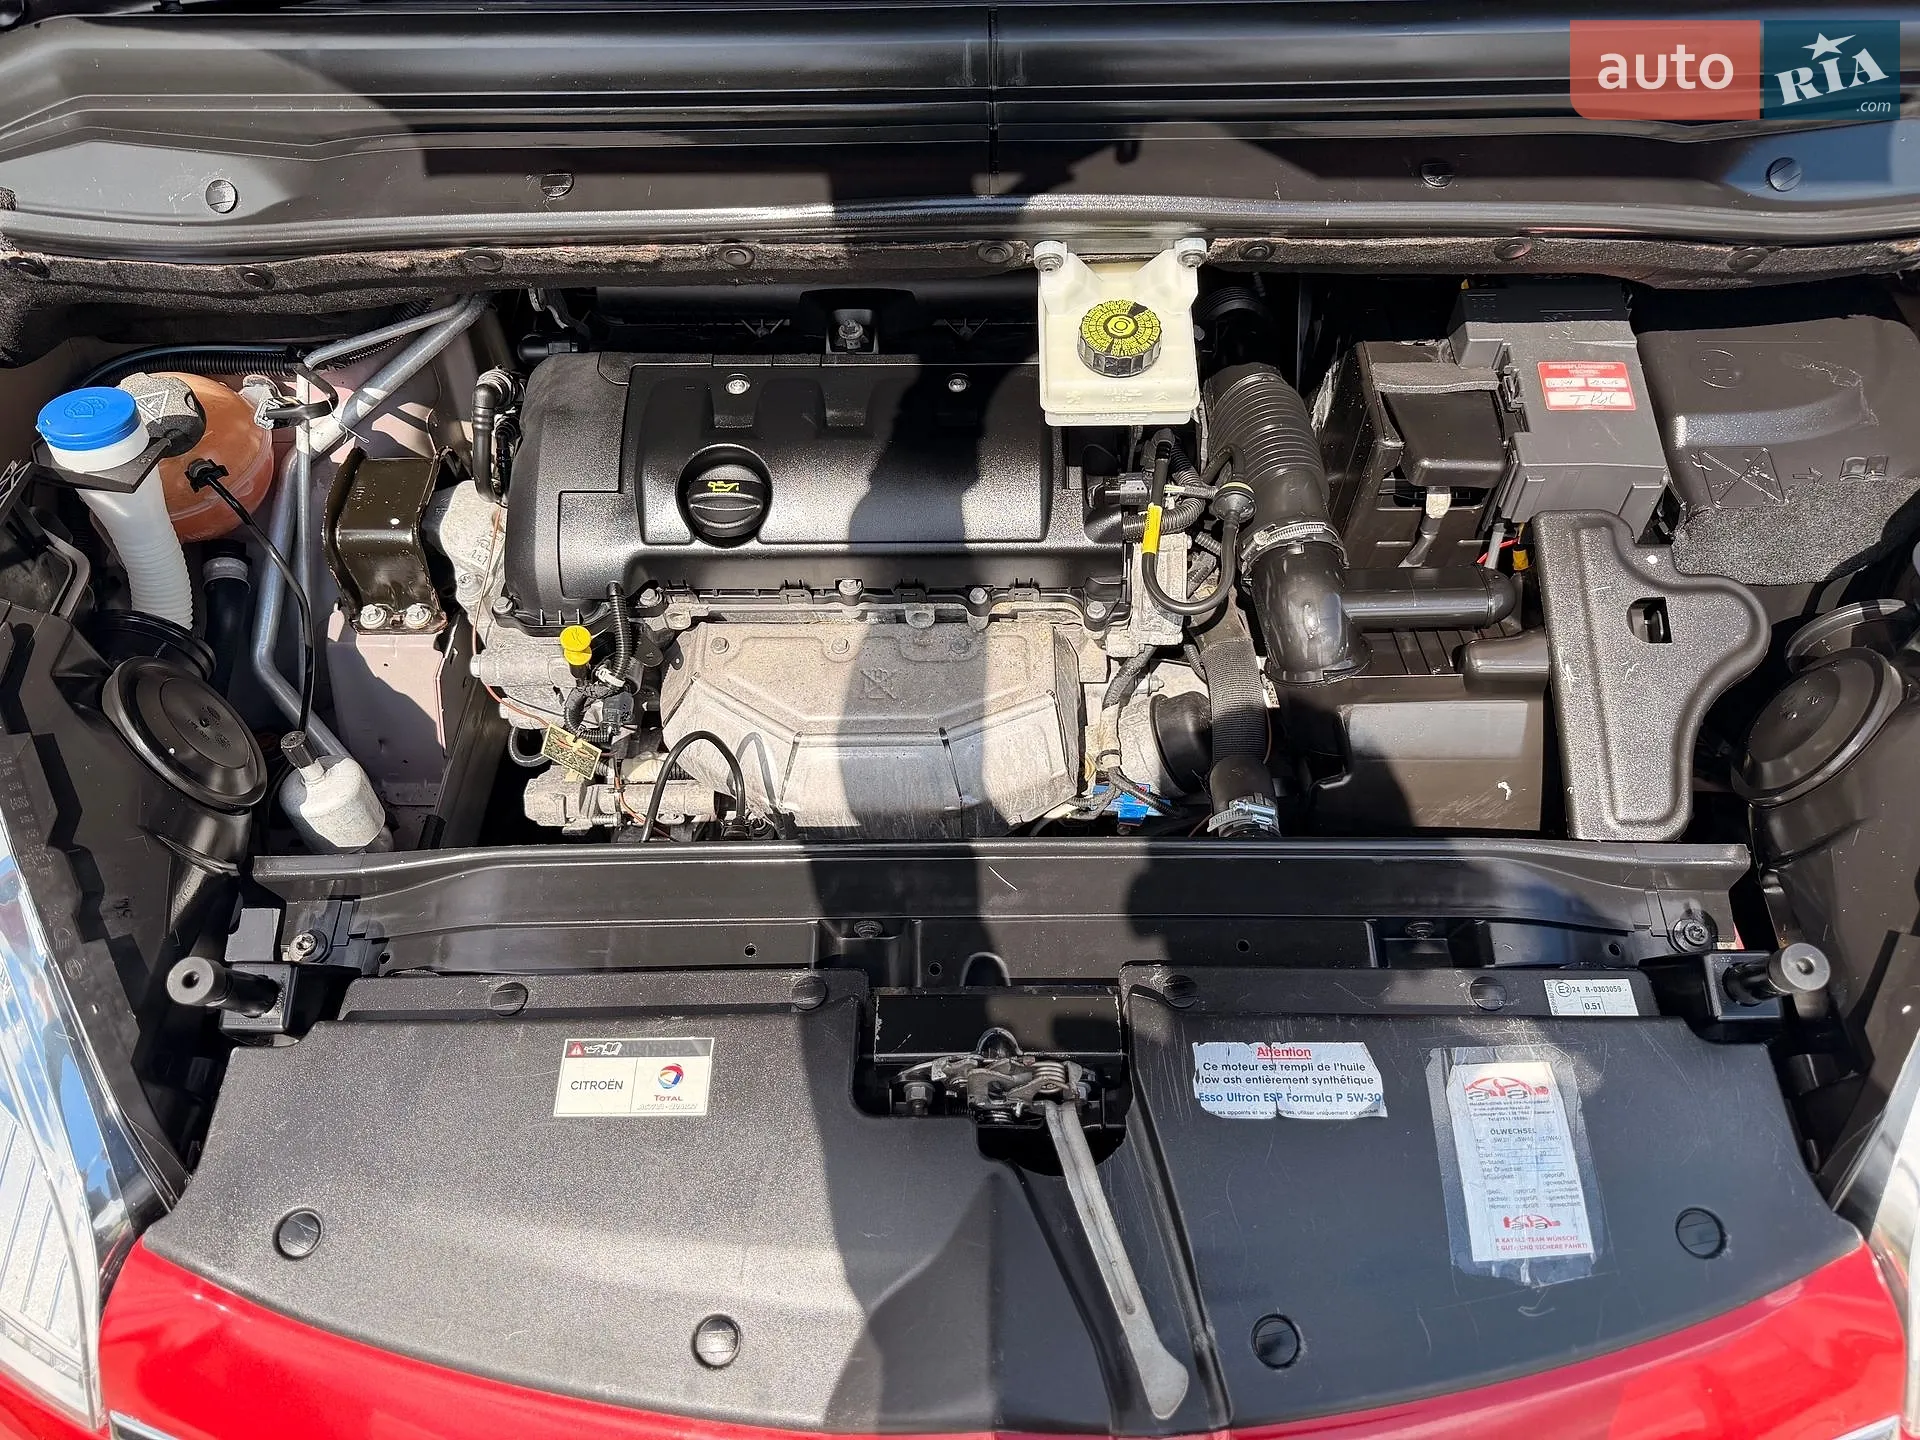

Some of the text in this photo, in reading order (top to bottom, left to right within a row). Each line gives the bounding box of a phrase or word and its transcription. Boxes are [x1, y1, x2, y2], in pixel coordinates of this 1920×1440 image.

[1257, 1046, 1312, 1057] Attention
[1203, 1063, 1218, 1071] Ce
[1280, 1063, 1314, 1073] rempli
[1317, 1063, 1330, 1071] de
[1333, 1062, 1366, 1071] l'huile
[570, 1079, 623, 1090] CITROËN
[1202, 1075, 1374, 1086] low ash entièrement synthétique
[1199, 1092, 1382, 1103] Esso Ultron ESP Formula P 5W-30
